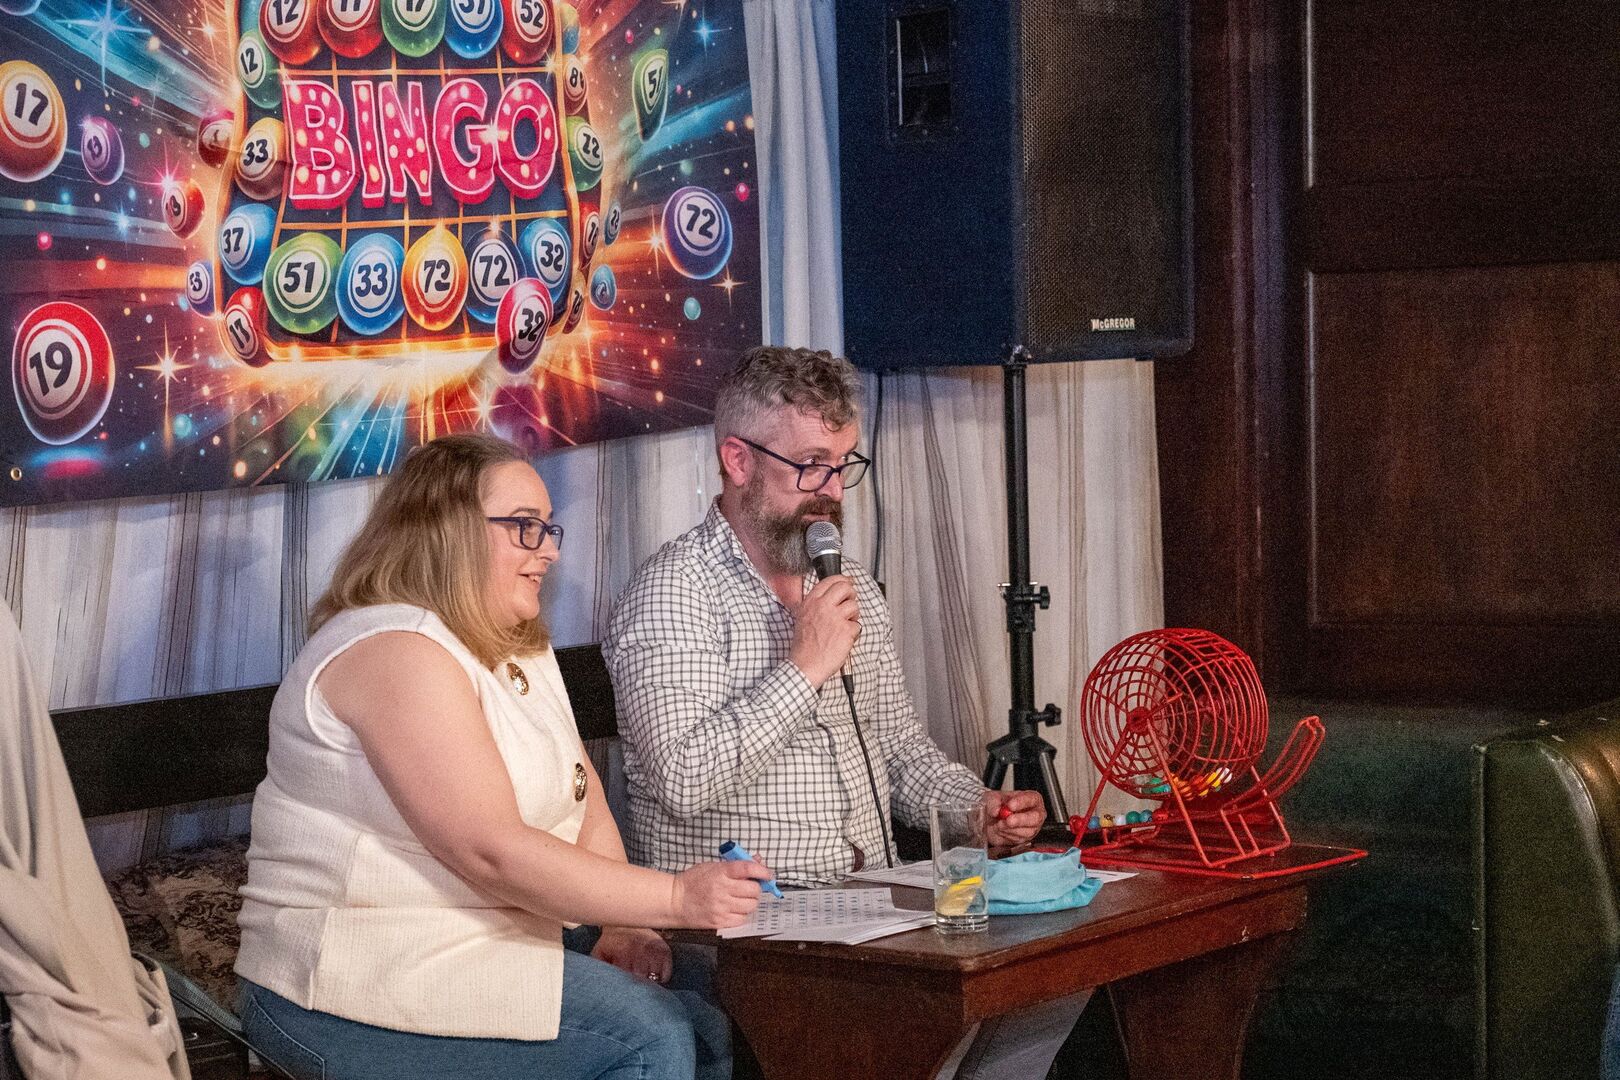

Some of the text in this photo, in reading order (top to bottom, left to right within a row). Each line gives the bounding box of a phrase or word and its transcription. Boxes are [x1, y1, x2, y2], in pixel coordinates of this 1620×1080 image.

[520, 0, 544, 29] 52
[240, 47, 259, 75] 12
[15, 82, 49, 126] 17
[243, 139, 268, 167] 33
[283, 77, 558, 205] BINGO
[685, 204, 717, 239] 72
[222, 227, 245, 254] 37
[540, 241, 565, 272] 32
[283, 262, 316, 293] 51
[355, 262, 388, 298] 33
[423, 259, 451, 294] 72
[479, 254, 511, 288] 72
[1090, 318, 1136, 331] McGREGOR
[29, 341, 73, 397] 19
